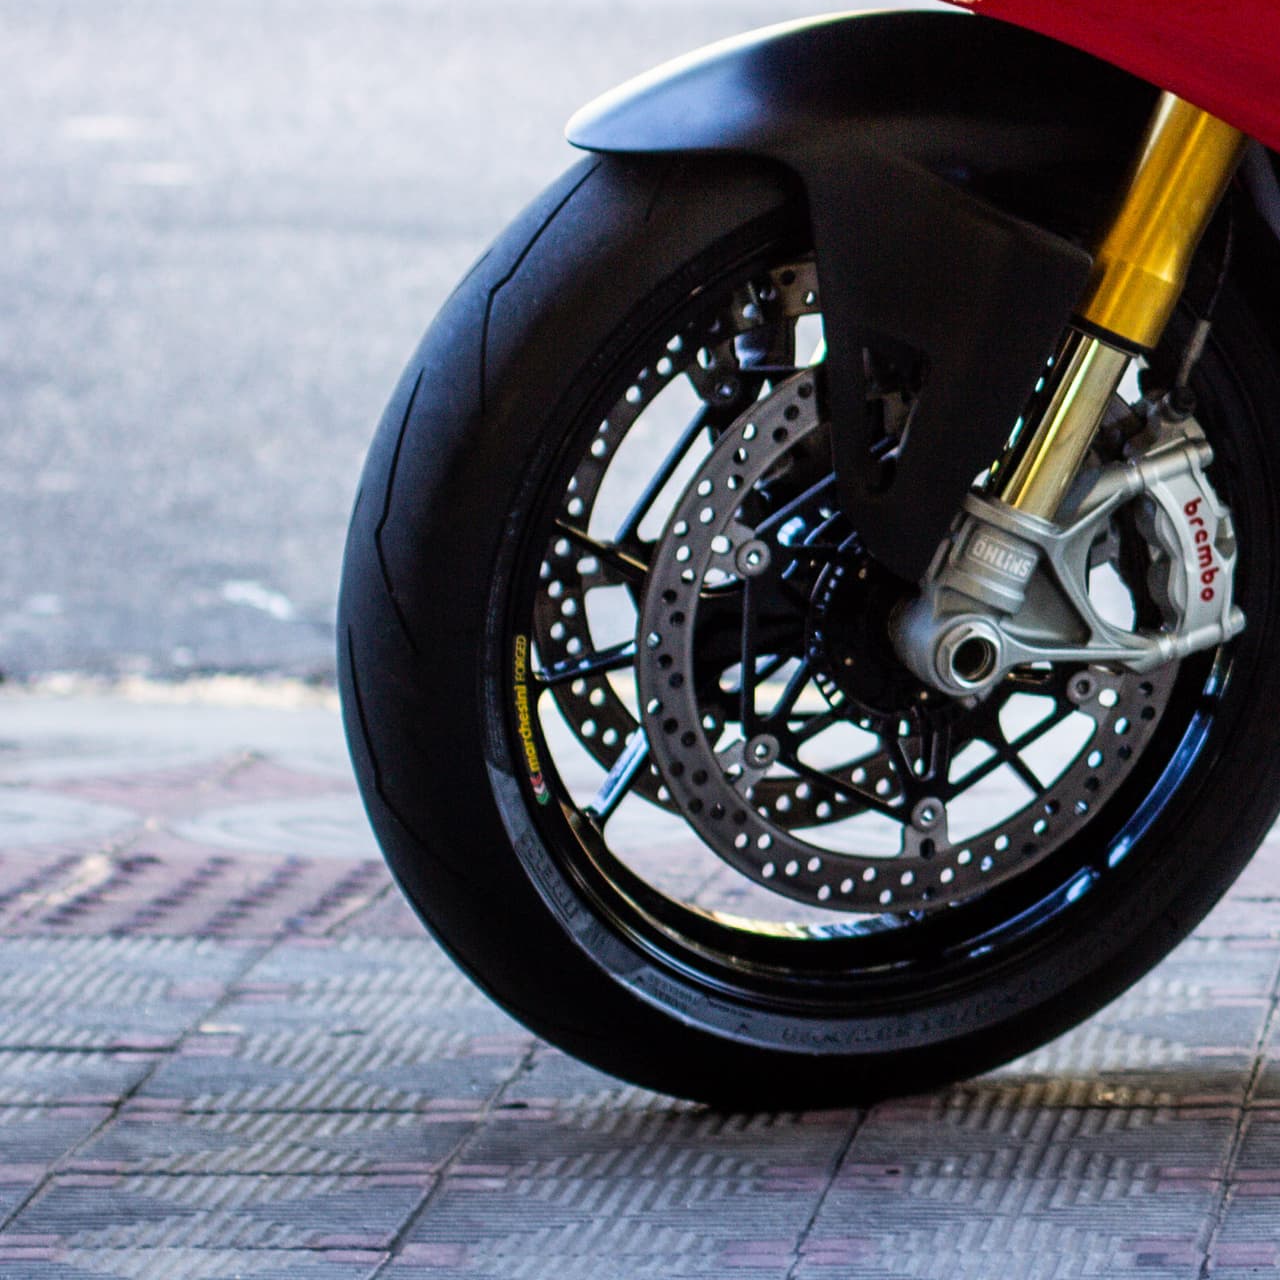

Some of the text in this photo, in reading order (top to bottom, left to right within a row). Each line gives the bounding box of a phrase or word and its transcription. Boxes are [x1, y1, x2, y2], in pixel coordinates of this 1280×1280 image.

[1184, 497, 1219, 602] brembo
[514, 634, 540, 773] marchesini FORGED
